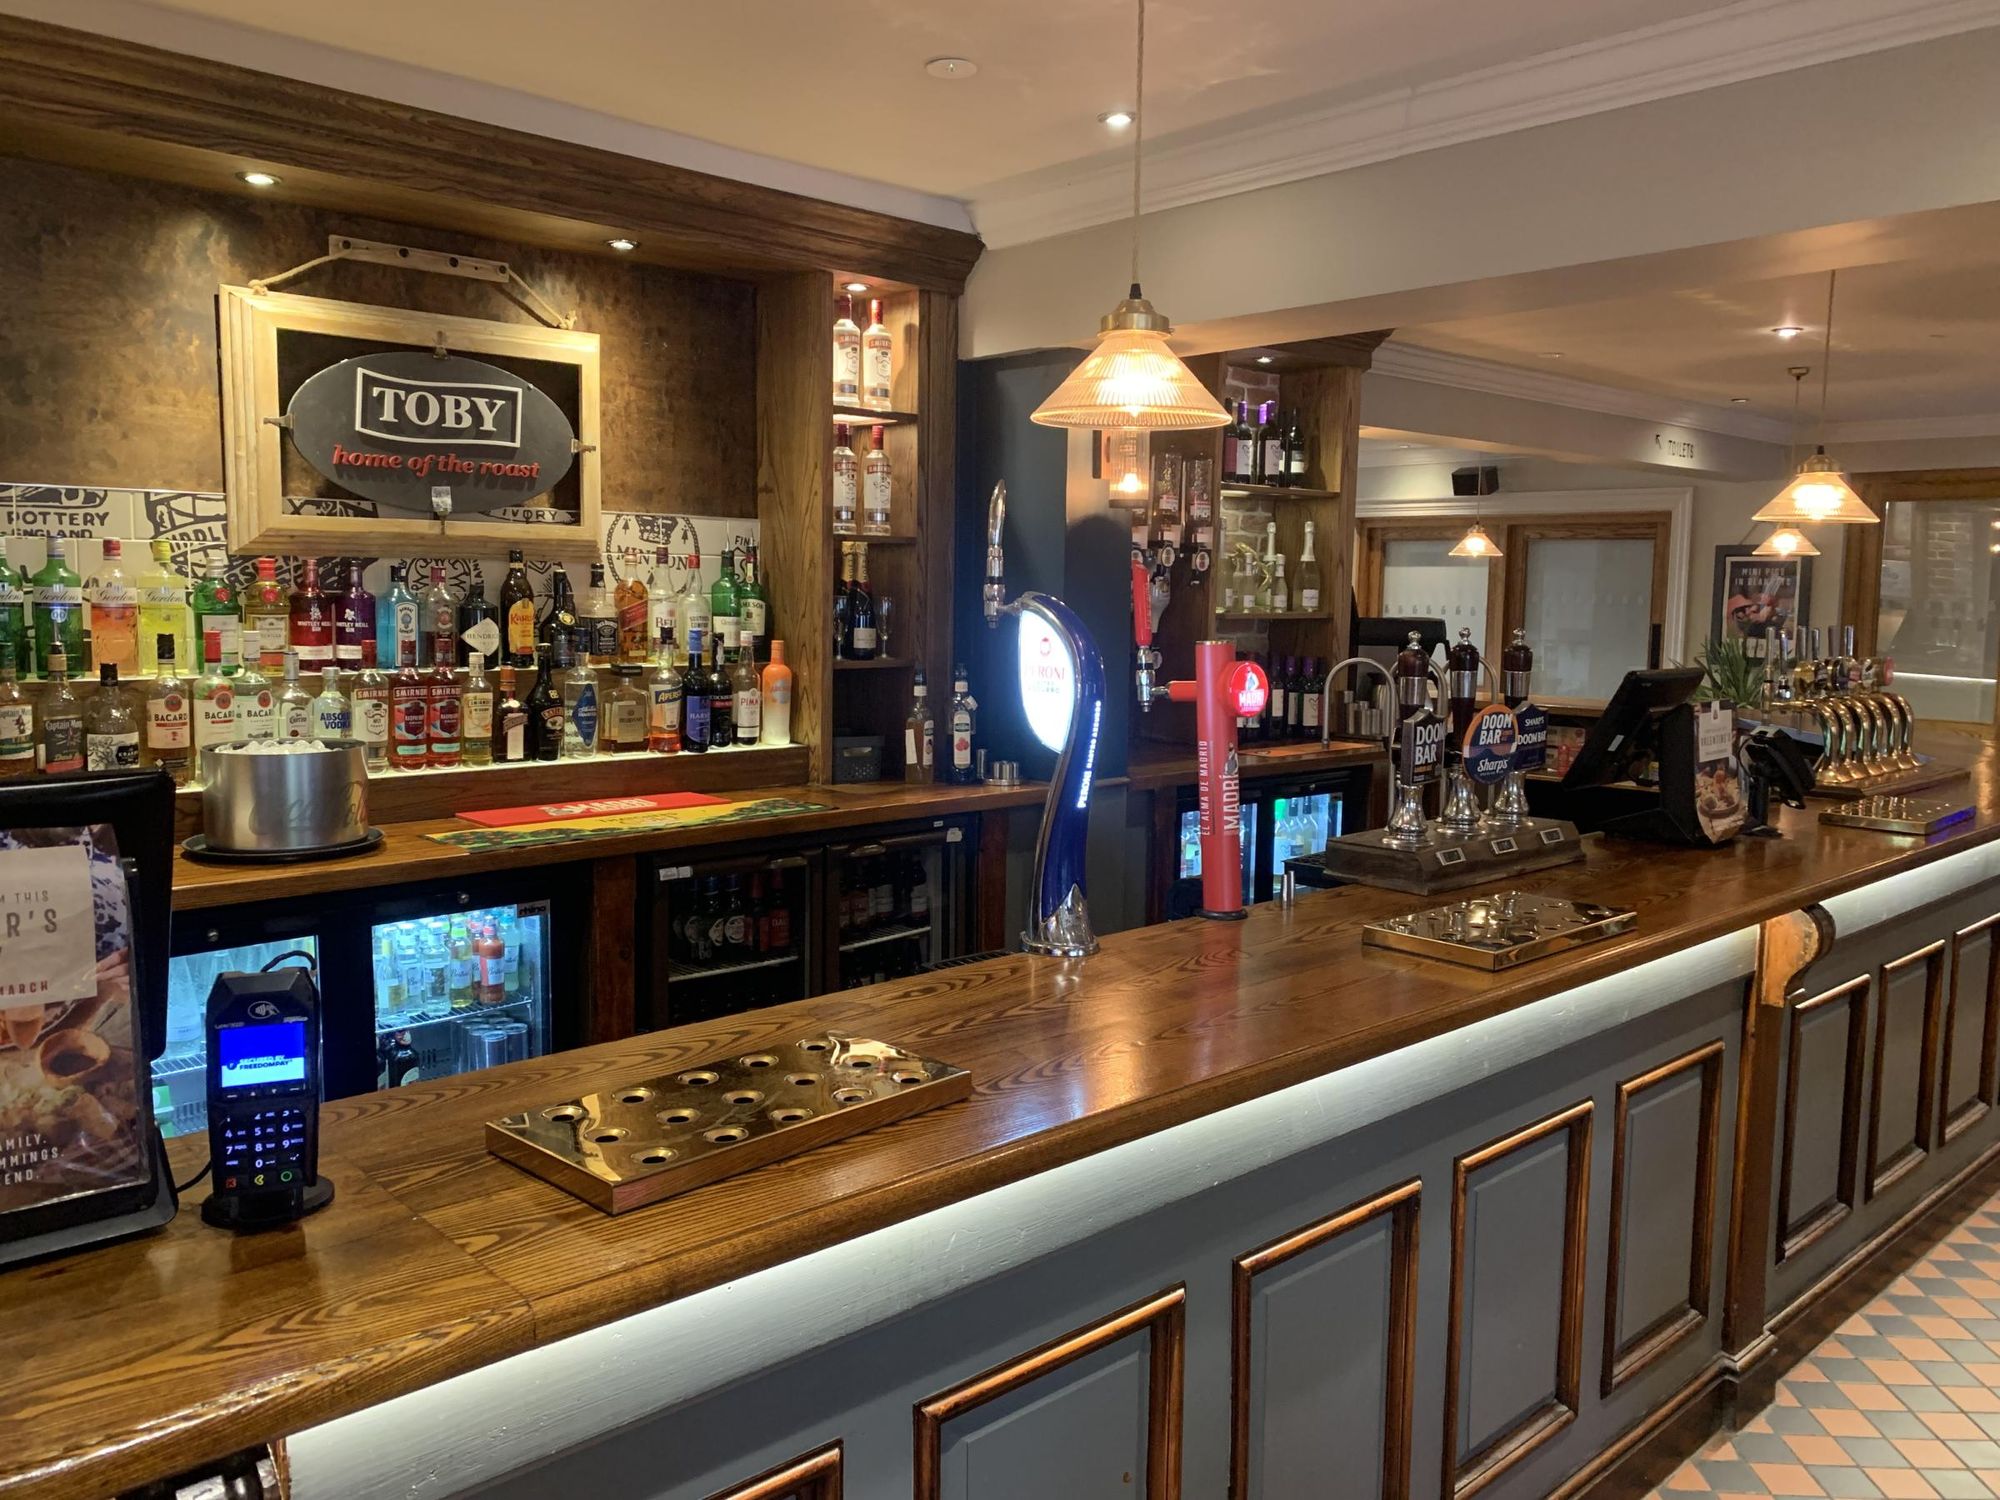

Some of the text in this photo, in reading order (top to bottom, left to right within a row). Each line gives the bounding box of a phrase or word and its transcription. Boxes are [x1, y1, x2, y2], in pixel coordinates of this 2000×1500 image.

[372, 386, 506, 432] TOBY
[332, 443, 541, 479] home of the roast
[7, 510, 109, 528] POTTERY
[502, 508, 559, 523] IVORY
[1482, 714, 1513, 729] DOOM
[1479, 729, 1502, 745] BAR
[1199, 741, 1208, 777] MADRID
[1415, 745, 1437, 765] BAR
[1477, 757, 1509, 774] Sharp's
[1200, 781, 1208, 792] DE
[1200, 796, 1209, 821] ALMA
[15, 890, 49, 903] THIS
[520, 905, 546, 915] rhino
[225, 1129, 232, 1138] 4
[255, 1127, 261, 1136] 5
[282, 1124, 290, 1132] 6
[226, 1146, 232, 1155] 7
[255, 1143, 262, 1152] 8
[282, 1140, 290, 1149] 9
[255, 1159, 263, 1168] 0
